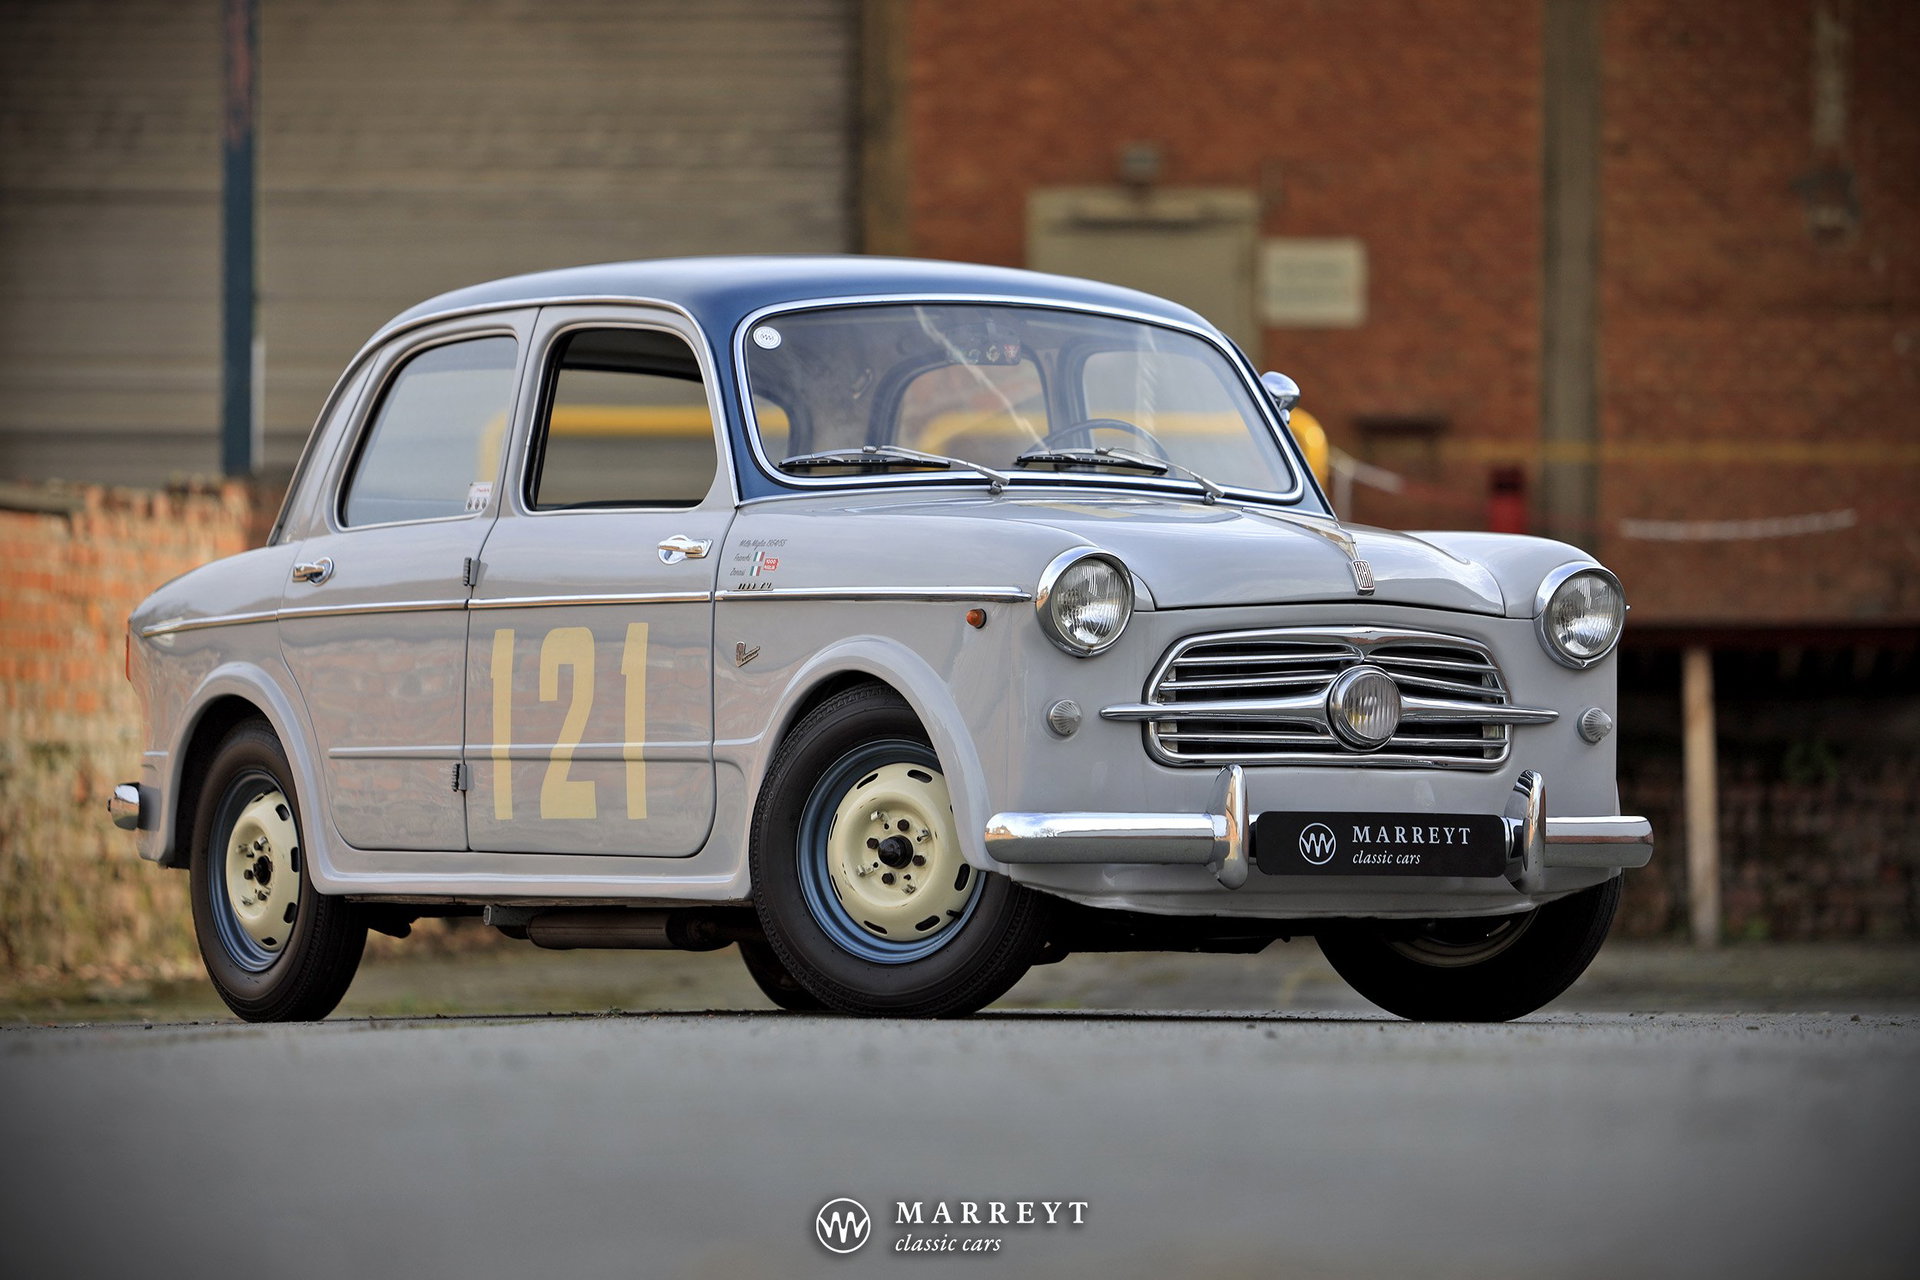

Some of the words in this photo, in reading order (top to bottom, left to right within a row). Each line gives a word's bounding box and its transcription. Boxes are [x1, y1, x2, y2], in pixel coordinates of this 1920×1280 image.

[490, 622, 649, 820] 121
[1352, 825, 1471, 845] MARREYT
[1352, 850, 1393, 865] classic
[1396, 854, 1421, 865] cars
